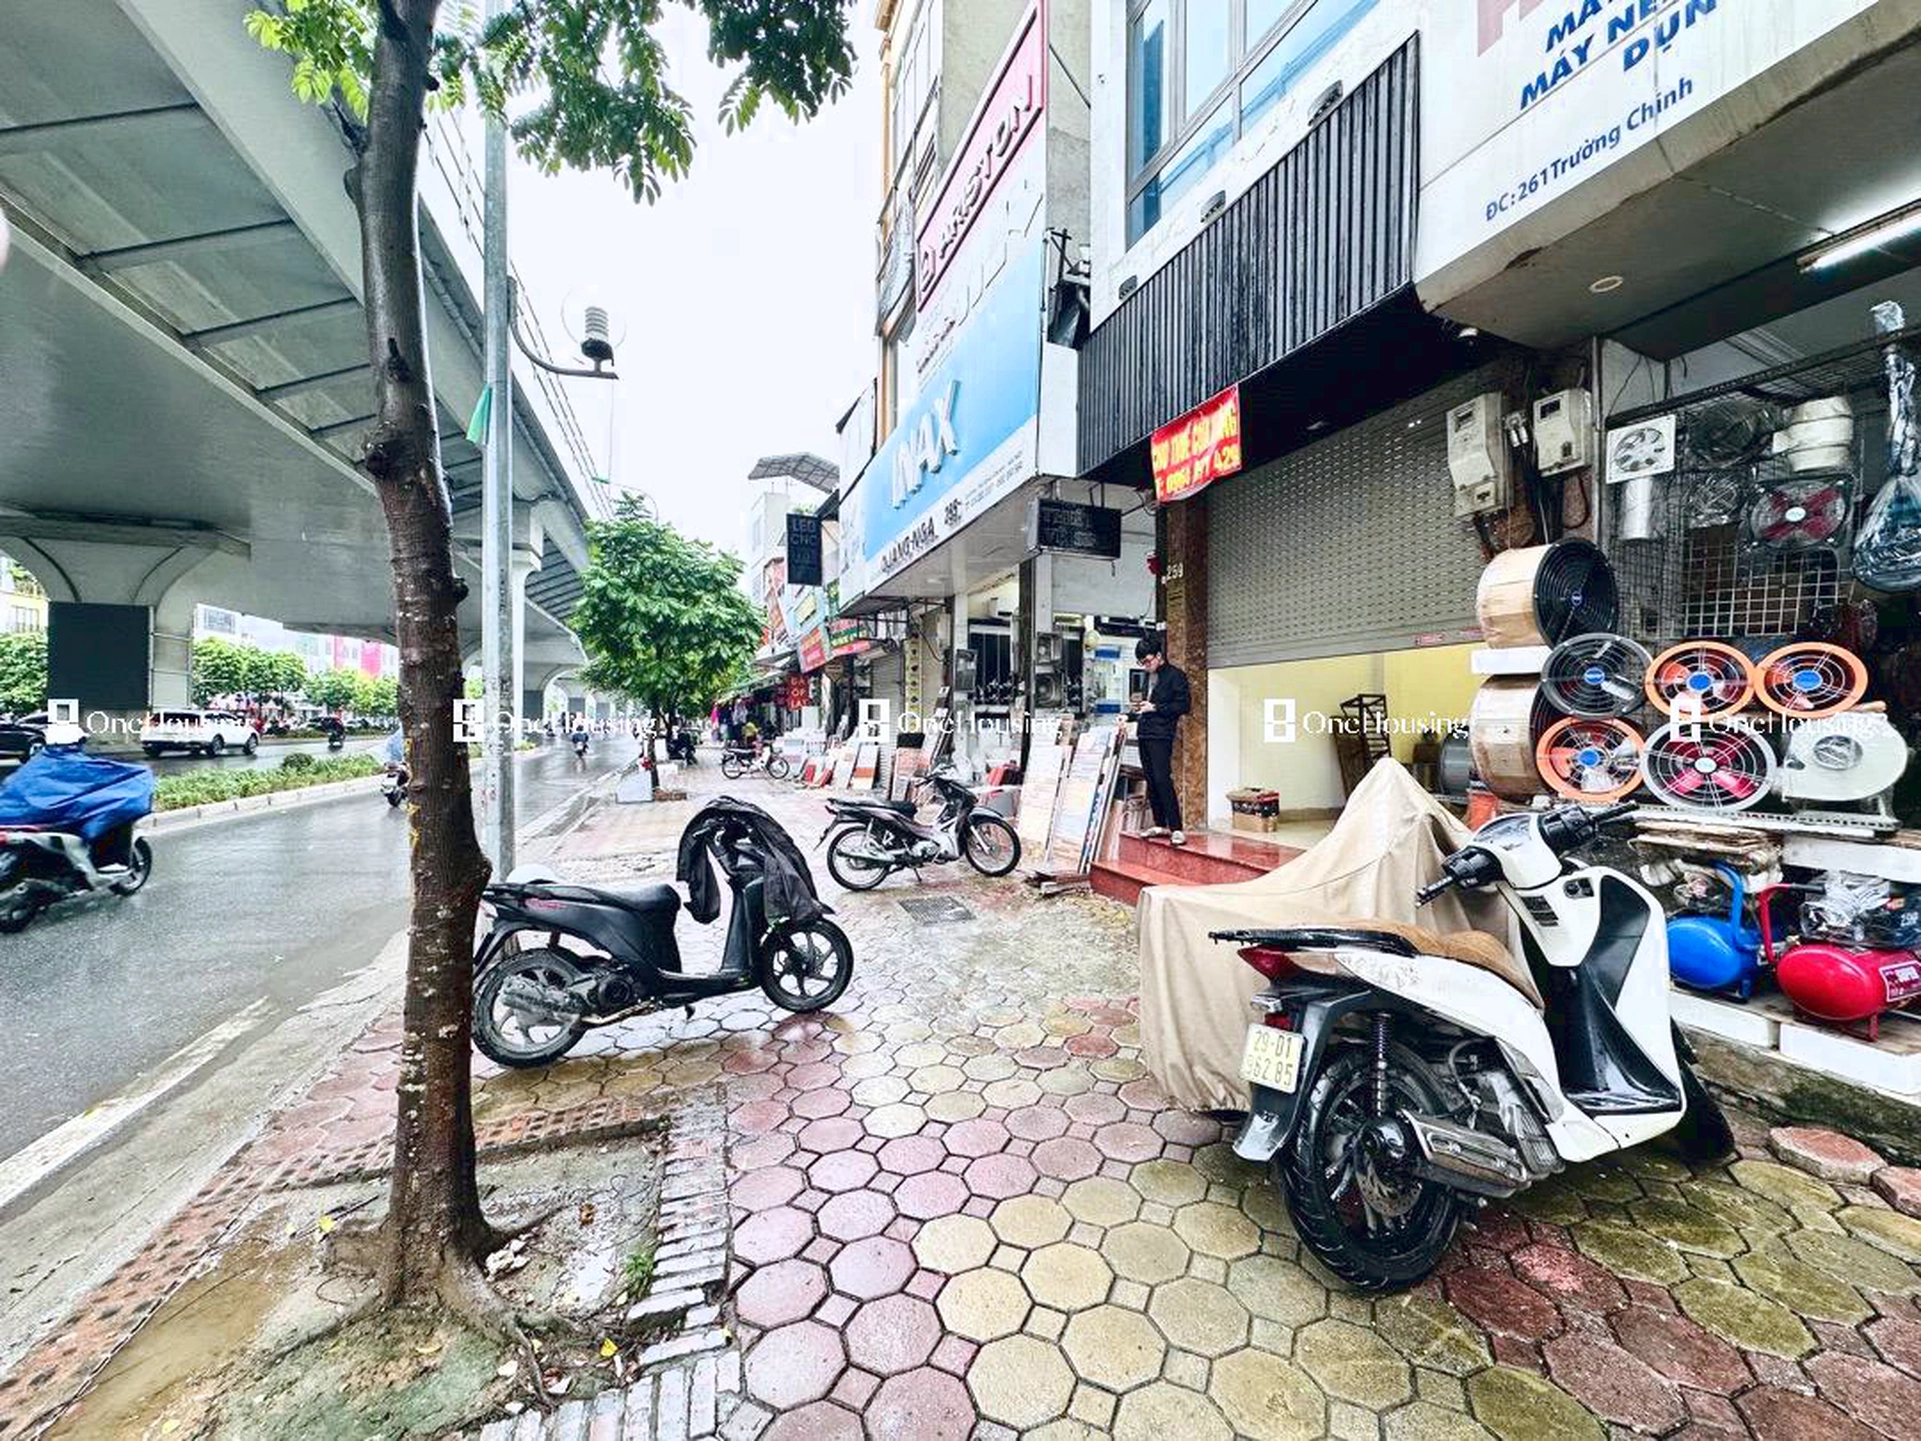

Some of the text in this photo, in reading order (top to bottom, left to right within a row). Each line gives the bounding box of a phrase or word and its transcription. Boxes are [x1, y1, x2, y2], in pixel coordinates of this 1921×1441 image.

[1520, 33, 1595, 110] MÁY
[1626, 77, 1693, 132] Chính
[1166, 562, 1184, 581] 259
